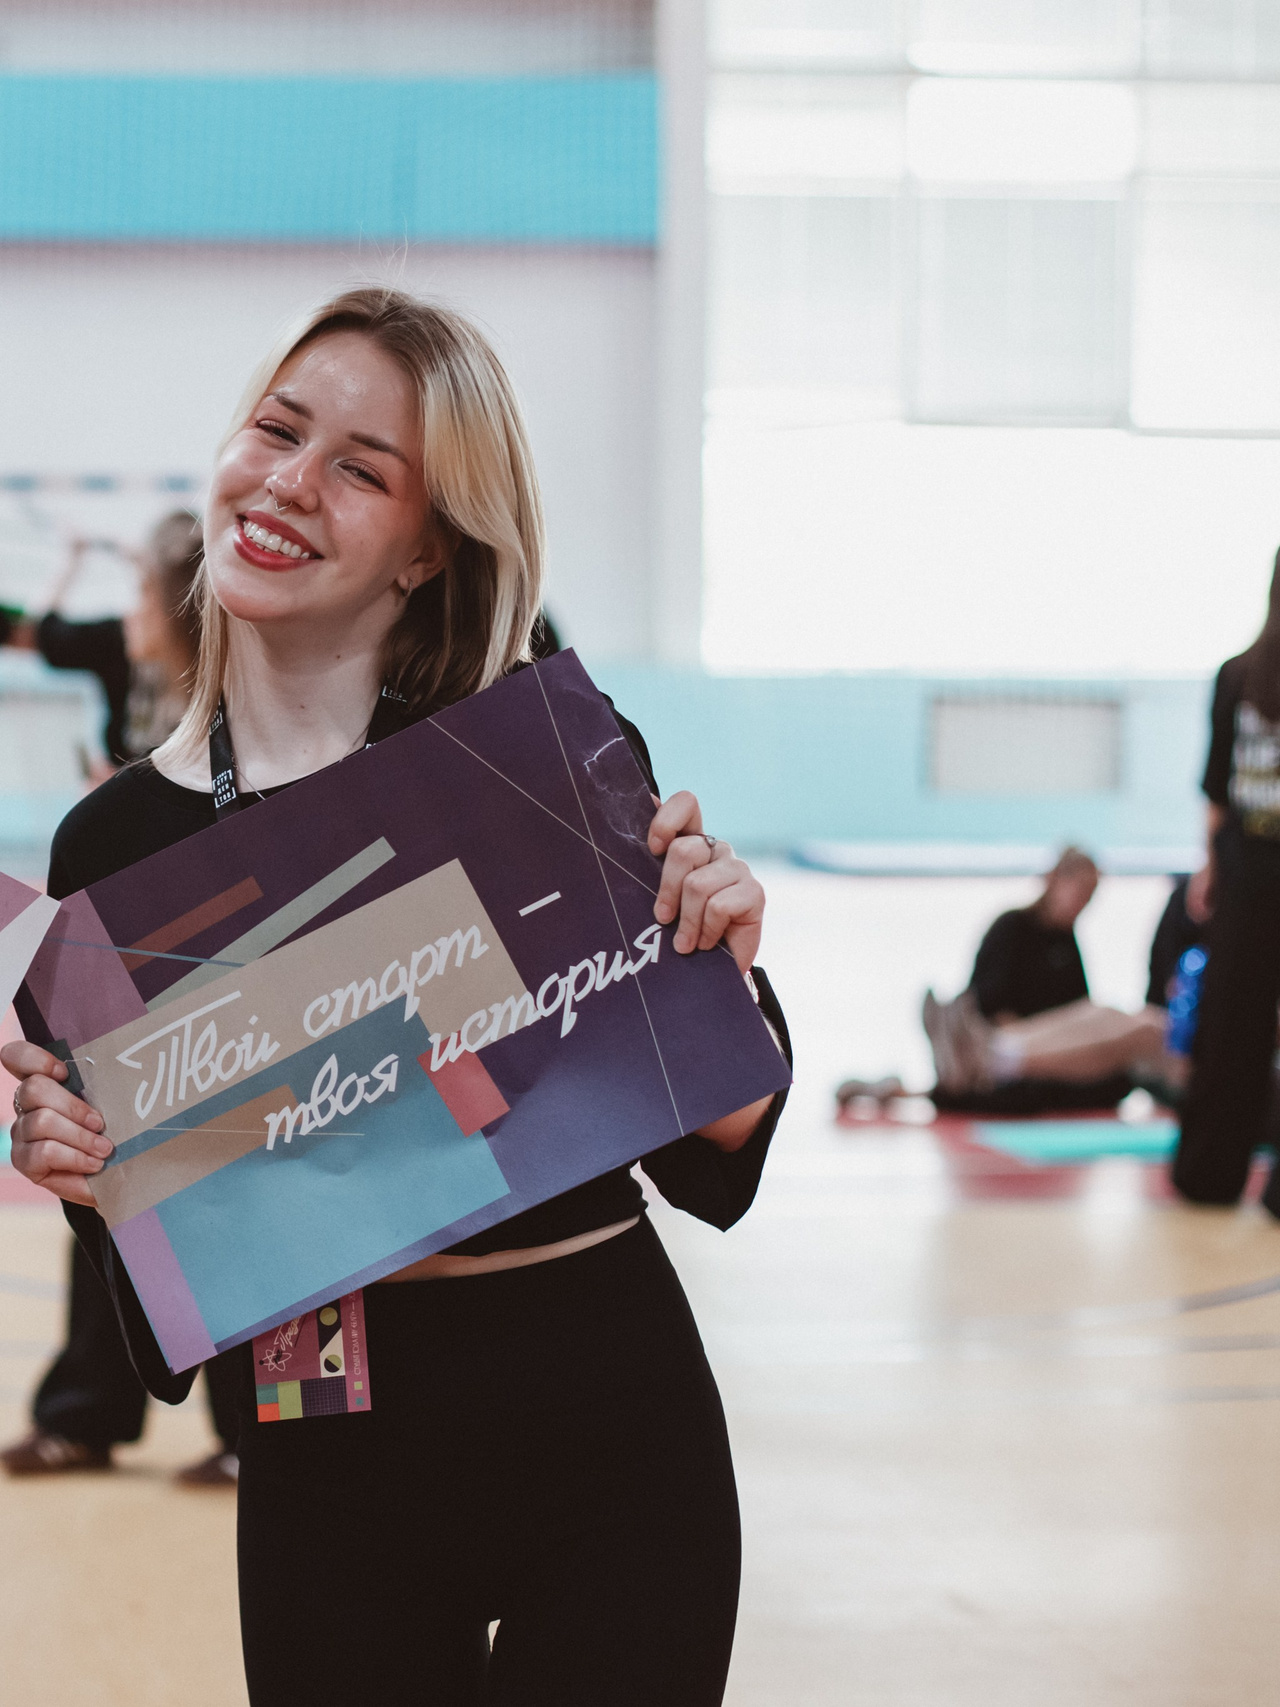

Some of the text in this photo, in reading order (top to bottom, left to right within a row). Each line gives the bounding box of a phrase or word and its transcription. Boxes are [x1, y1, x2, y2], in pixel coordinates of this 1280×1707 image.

[115, 990, 281, 1121] Твой
[302, 924, 490, 1038] старт
[263, 922, 663, 1151] твоя история
